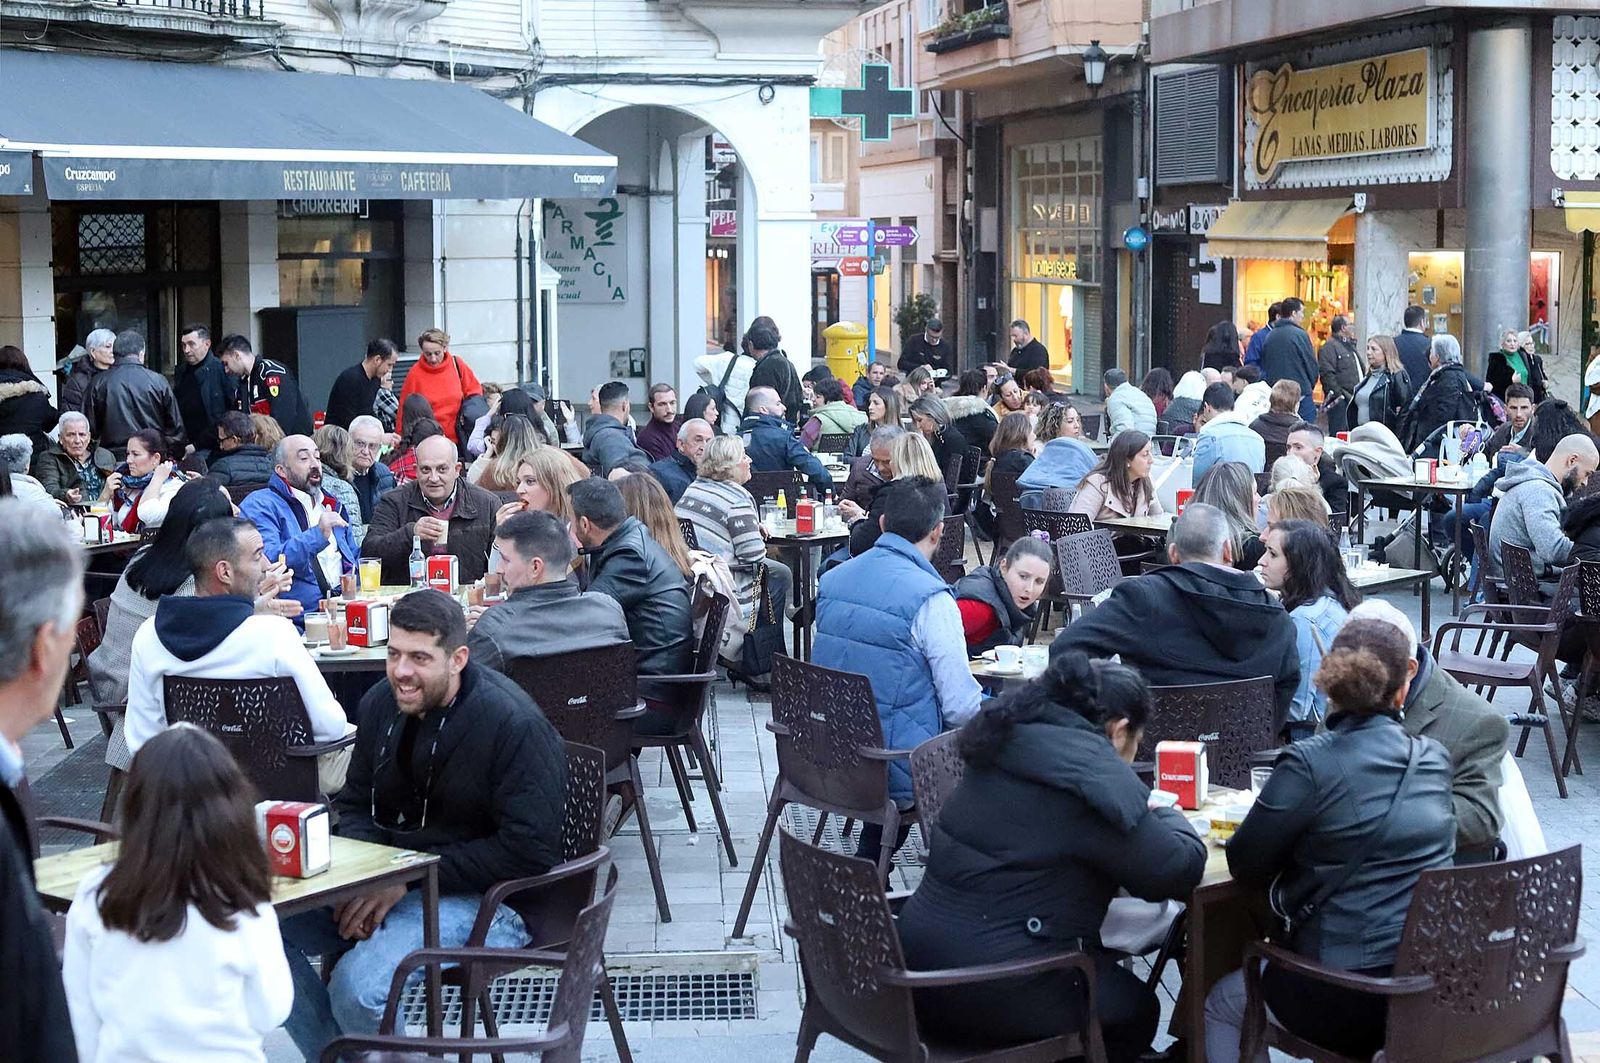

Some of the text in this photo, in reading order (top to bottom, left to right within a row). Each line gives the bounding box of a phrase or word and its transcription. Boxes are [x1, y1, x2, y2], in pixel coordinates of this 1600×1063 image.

[1357, 60, 1425, 104] Plaza
[1371, 124, 1418, 150] LABORES
[65, 166, 116, 183] Cruzcampo
[283, 169, 357, 191] RESTAURANTE
[400, 169, 451, 192] CAFETERÍA
[550, 263, 581, 273] armen
